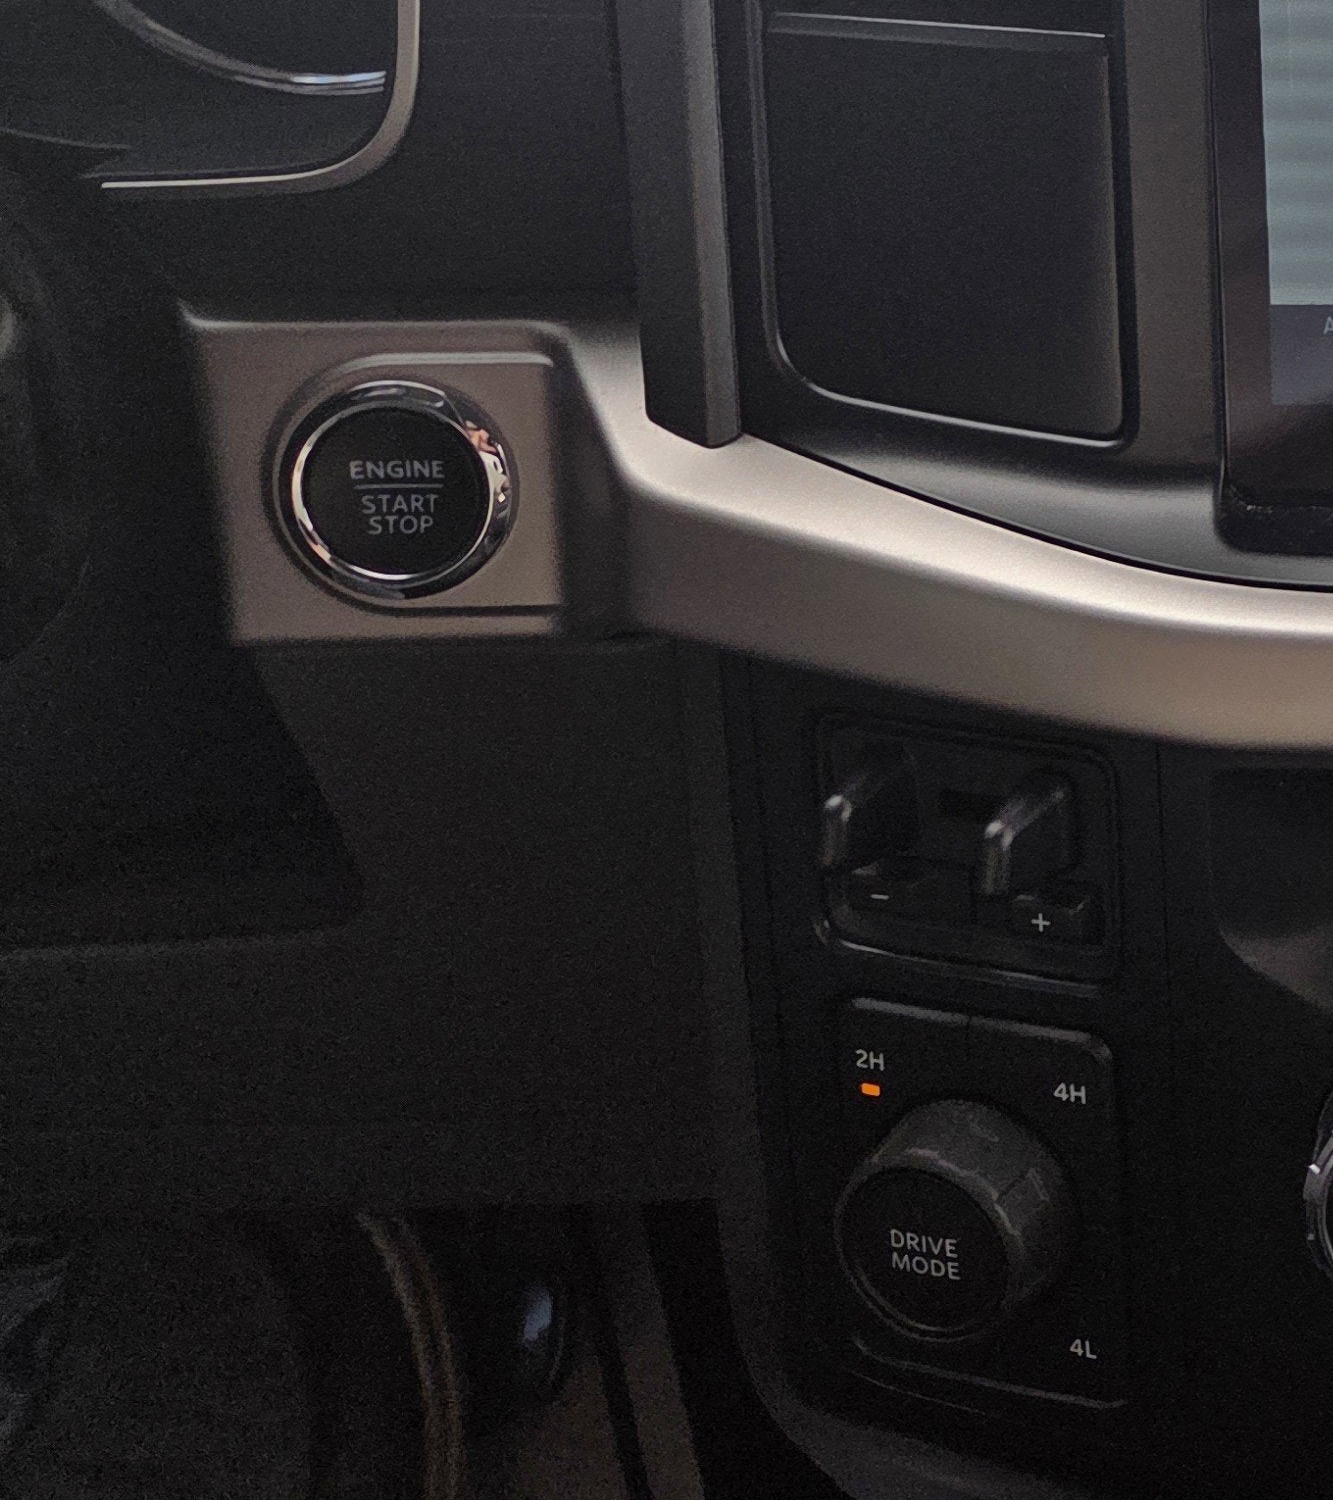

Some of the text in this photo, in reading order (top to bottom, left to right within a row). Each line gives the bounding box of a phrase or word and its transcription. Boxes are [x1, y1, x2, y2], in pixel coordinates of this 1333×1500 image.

[348, 460, 444, 480] ENGINE
[361, 493, 439, 515] START
[368, 514, 434, 535] STOP
[855, 1048, 885, 1071] 2H
[1053, 1082, 1087, 1105] 4H
[889, 1228, 958, 1258] DRIVE
[891, 1251, 960, 1281] MODE
[1069, 1338, 1097, 1360] 4L
